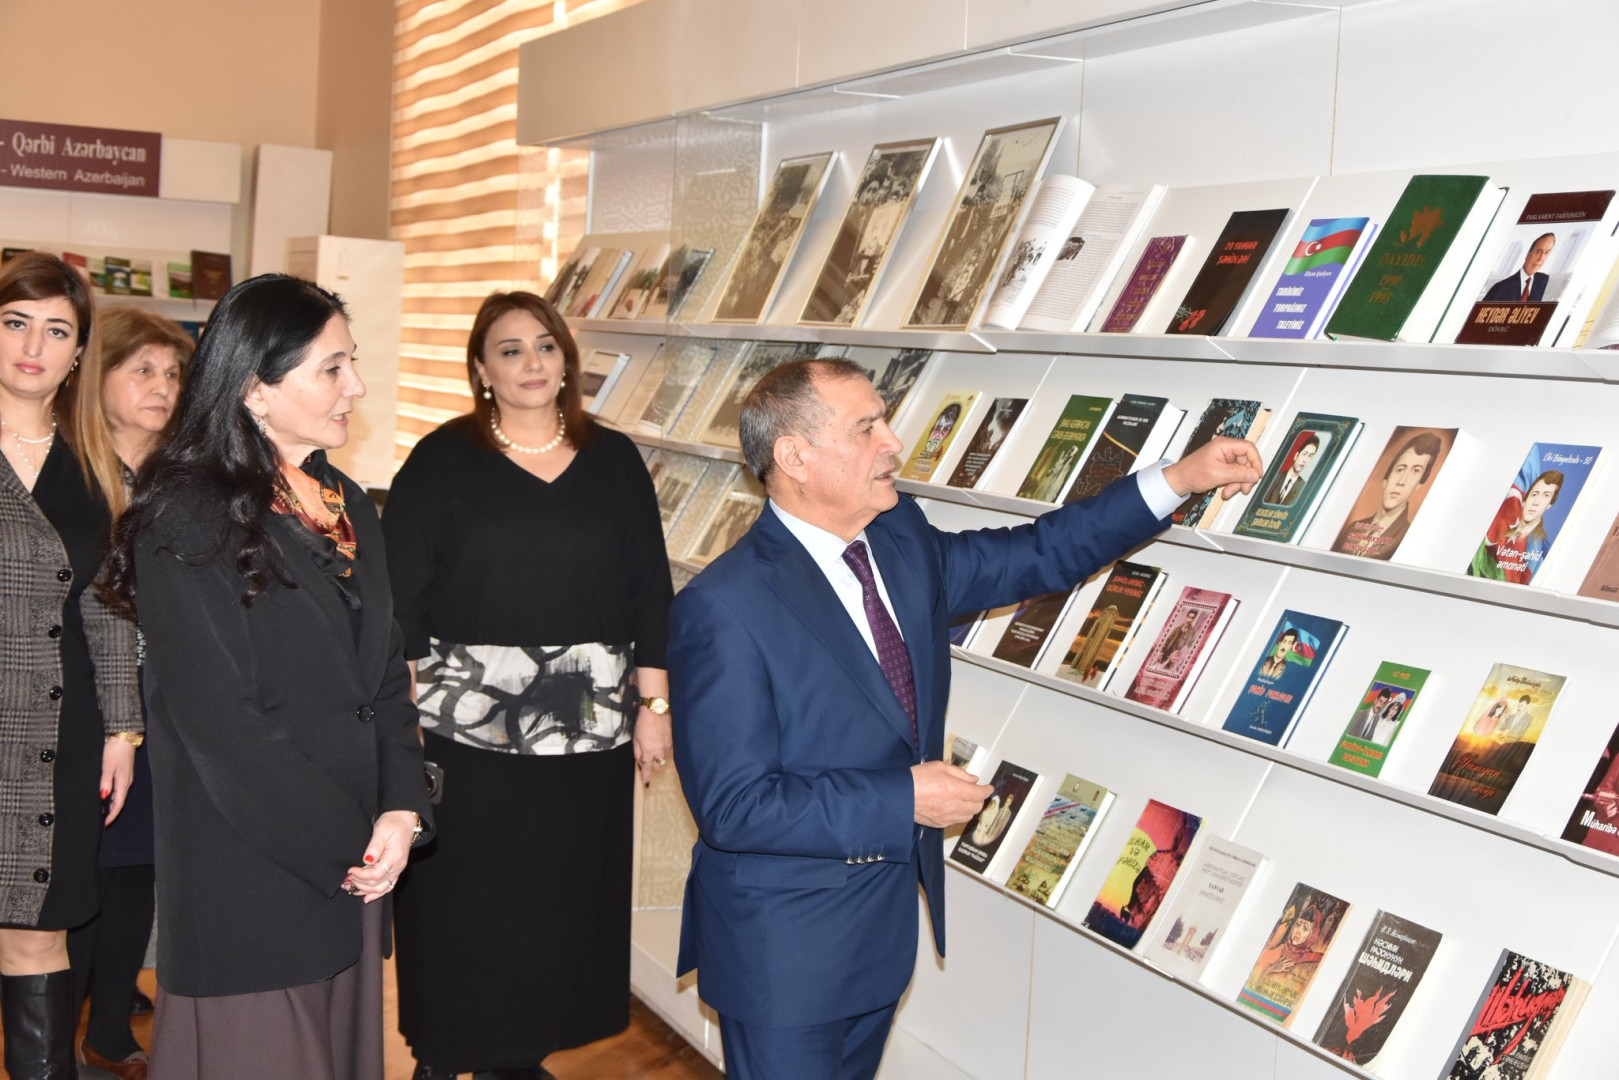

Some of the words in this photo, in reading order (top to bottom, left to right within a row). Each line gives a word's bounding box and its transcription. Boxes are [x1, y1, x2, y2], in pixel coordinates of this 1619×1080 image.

[12, 131, 55, 156] Qərbi
[61, 137, 146, 165] Azərbaycan
[10, 164, 67, 180] Western
[74, 169, 145, 188] Azerbaijan
[1234, 241, 1258, 249] YANVAR
[1475, 307, 1510, 324] HEYDƏR
[1509, 305, 1541, 324] ƏLİYEV
[1580, 810, 1617, 834] Müharibə
